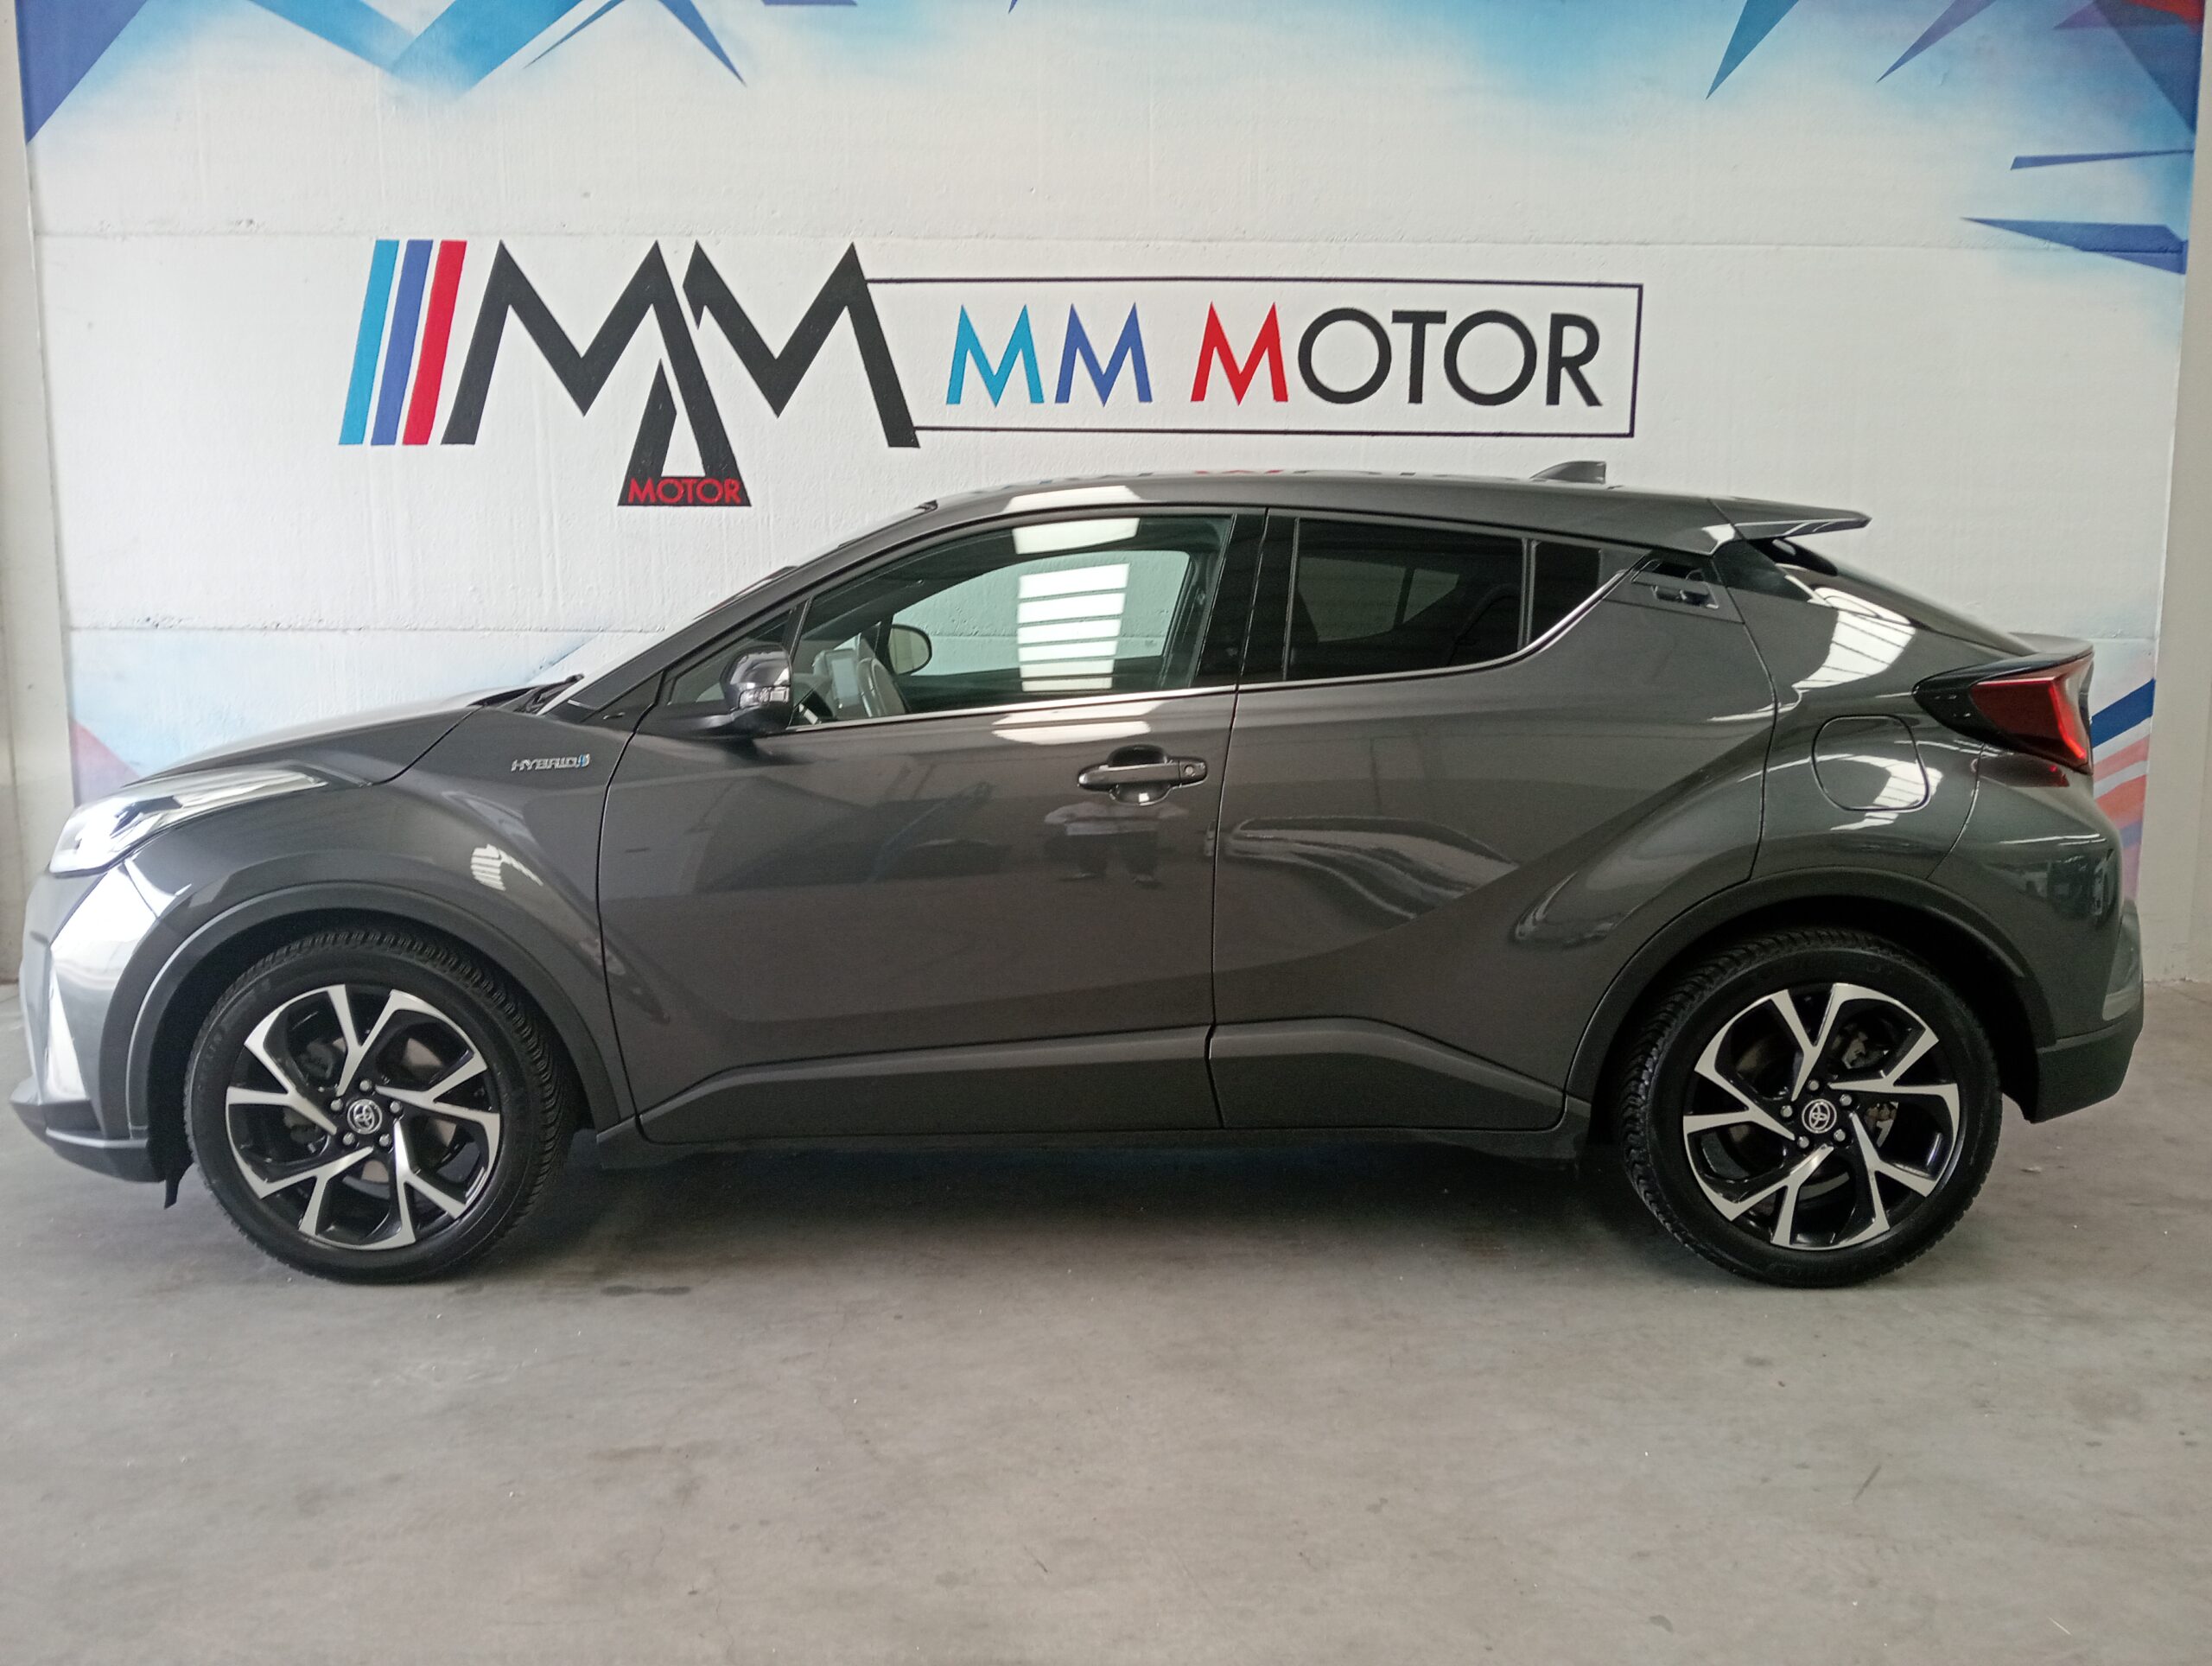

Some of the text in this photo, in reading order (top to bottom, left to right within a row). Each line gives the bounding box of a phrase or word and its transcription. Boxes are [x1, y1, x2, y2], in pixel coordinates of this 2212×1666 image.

[946, 302, 1604, 407] MM MOTOR
[627, 477, 742, 505] MOTOR
[511, 757, 579, 772] HYBRID
